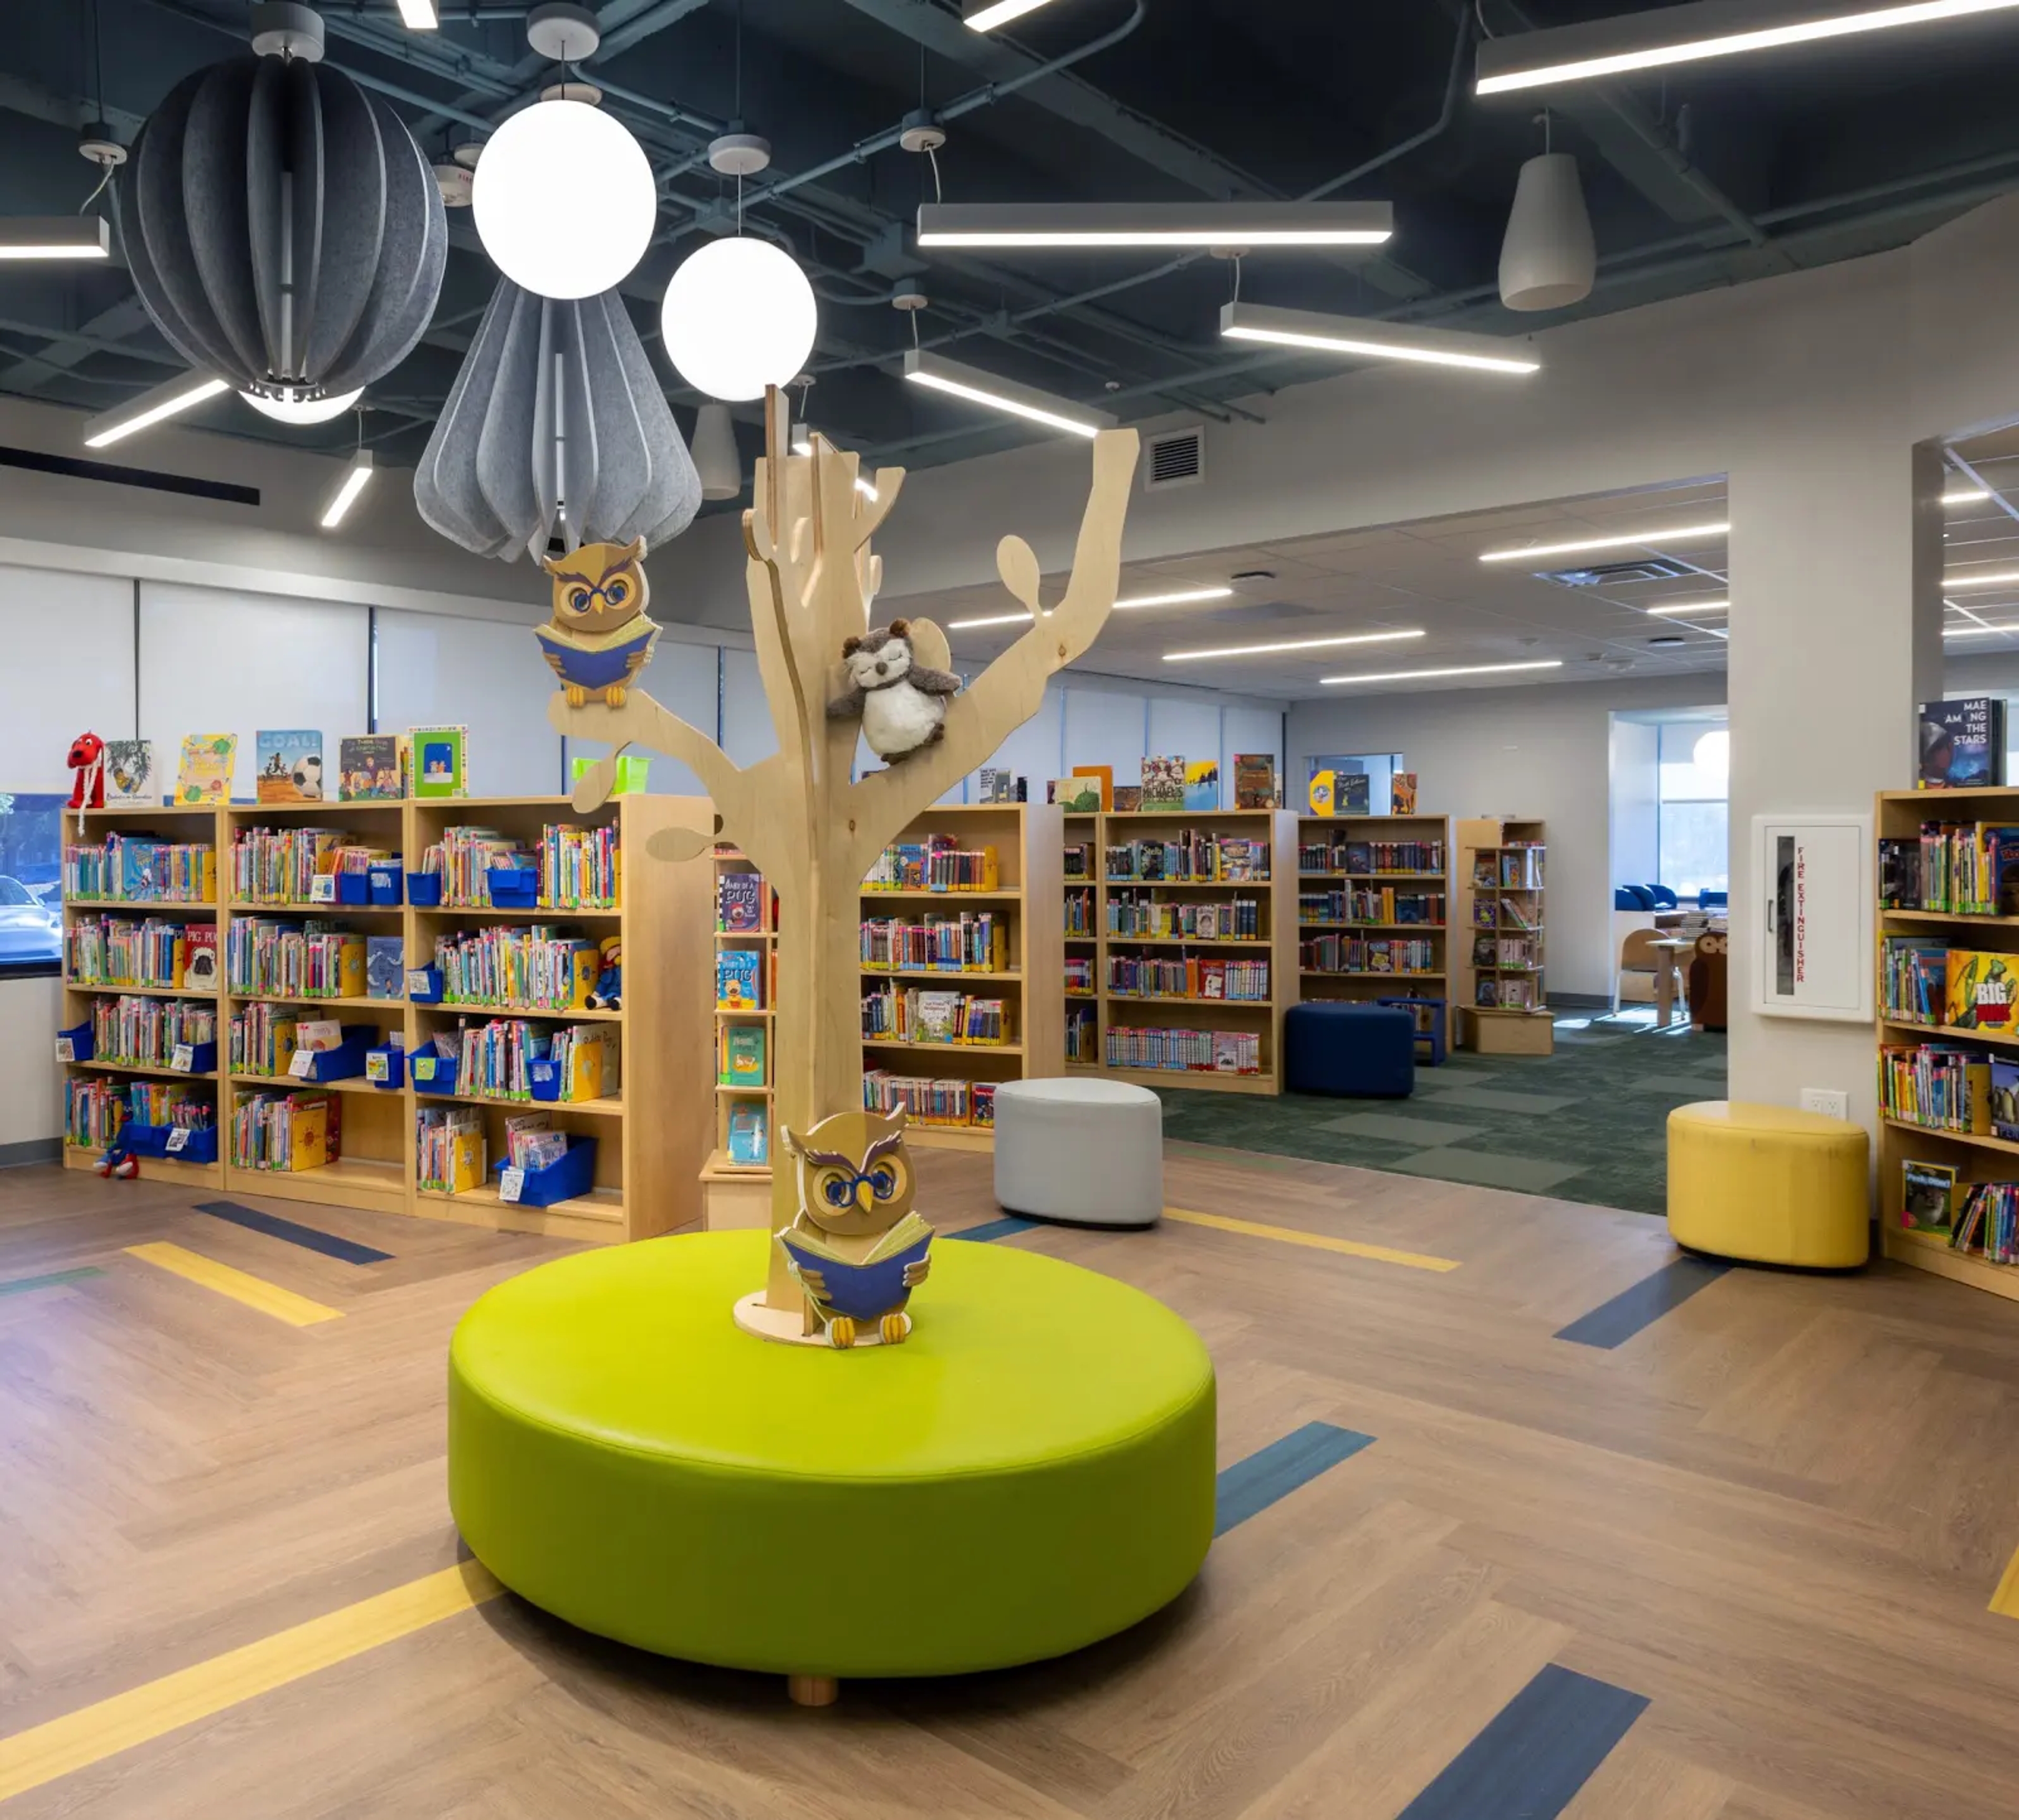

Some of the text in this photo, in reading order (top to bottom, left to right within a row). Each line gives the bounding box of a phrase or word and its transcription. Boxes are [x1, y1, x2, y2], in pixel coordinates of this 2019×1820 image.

[1963, 700, 1987, 710] MAE
[1965, 723, 1987, 733] THE
[1953, 735, 1987, 746] STARS
[726, 891, 756, 904] PUG
[187, 931, 201, 942] PIG
[1797, 883, 1805, 983] EXTINGUISHER
[723, 969, 752, 982] PUG
[1976, 982, 2007, 1004] BIG
